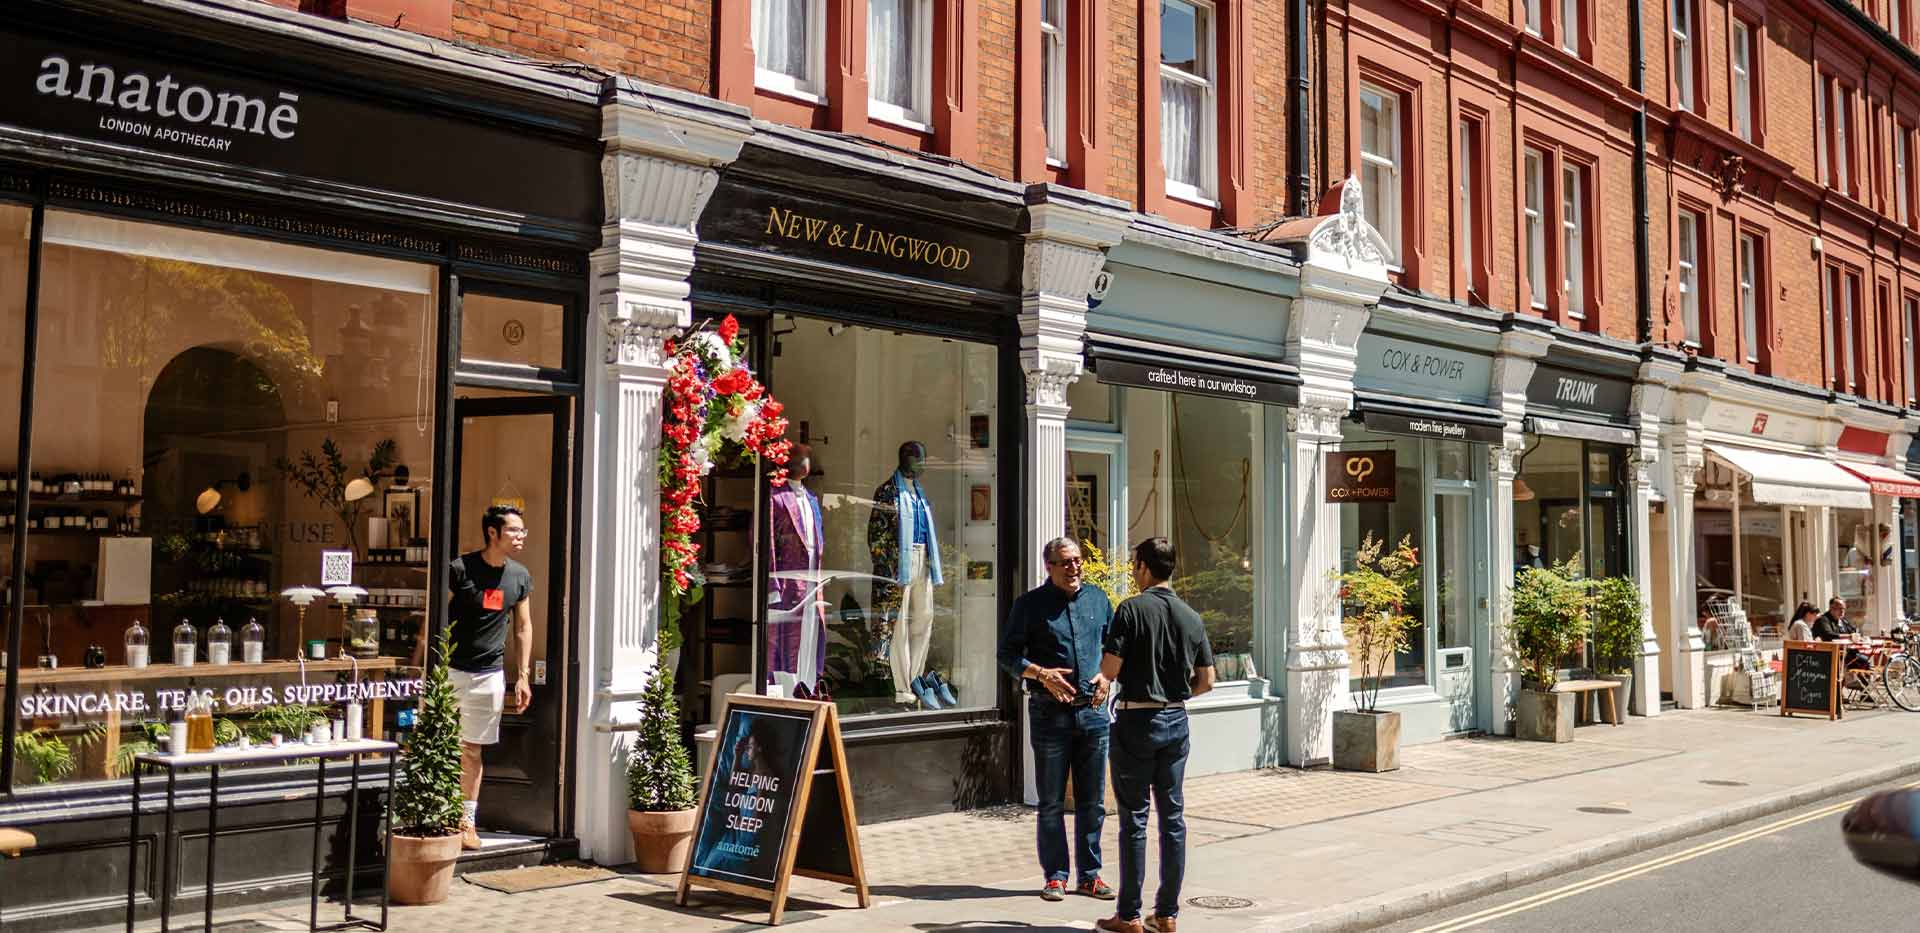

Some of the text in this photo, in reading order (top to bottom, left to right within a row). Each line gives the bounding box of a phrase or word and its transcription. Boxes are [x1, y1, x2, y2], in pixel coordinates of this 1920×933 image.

[36, 57, 299, 139] anatomē
[99, 116, 232, 151] LONDON APOTHECARY
[828, 224, 849, 248] &
[1382, 349, 1464, 380] COX & POWER
[1148, 368, 1257, 398] crafted here in our workshop
[1555, 377, 1598, 405] TRUNK
[1409, 419, 1432, 432] modern
[20, 690, 150, 716] SKINCARE.
[225, 687, 278, 706] OILS.
[729, 771, 780, 791] HELPING
[724, 792, 775, 813] LONDON
[726, 814, 763, 833] SLEEP
